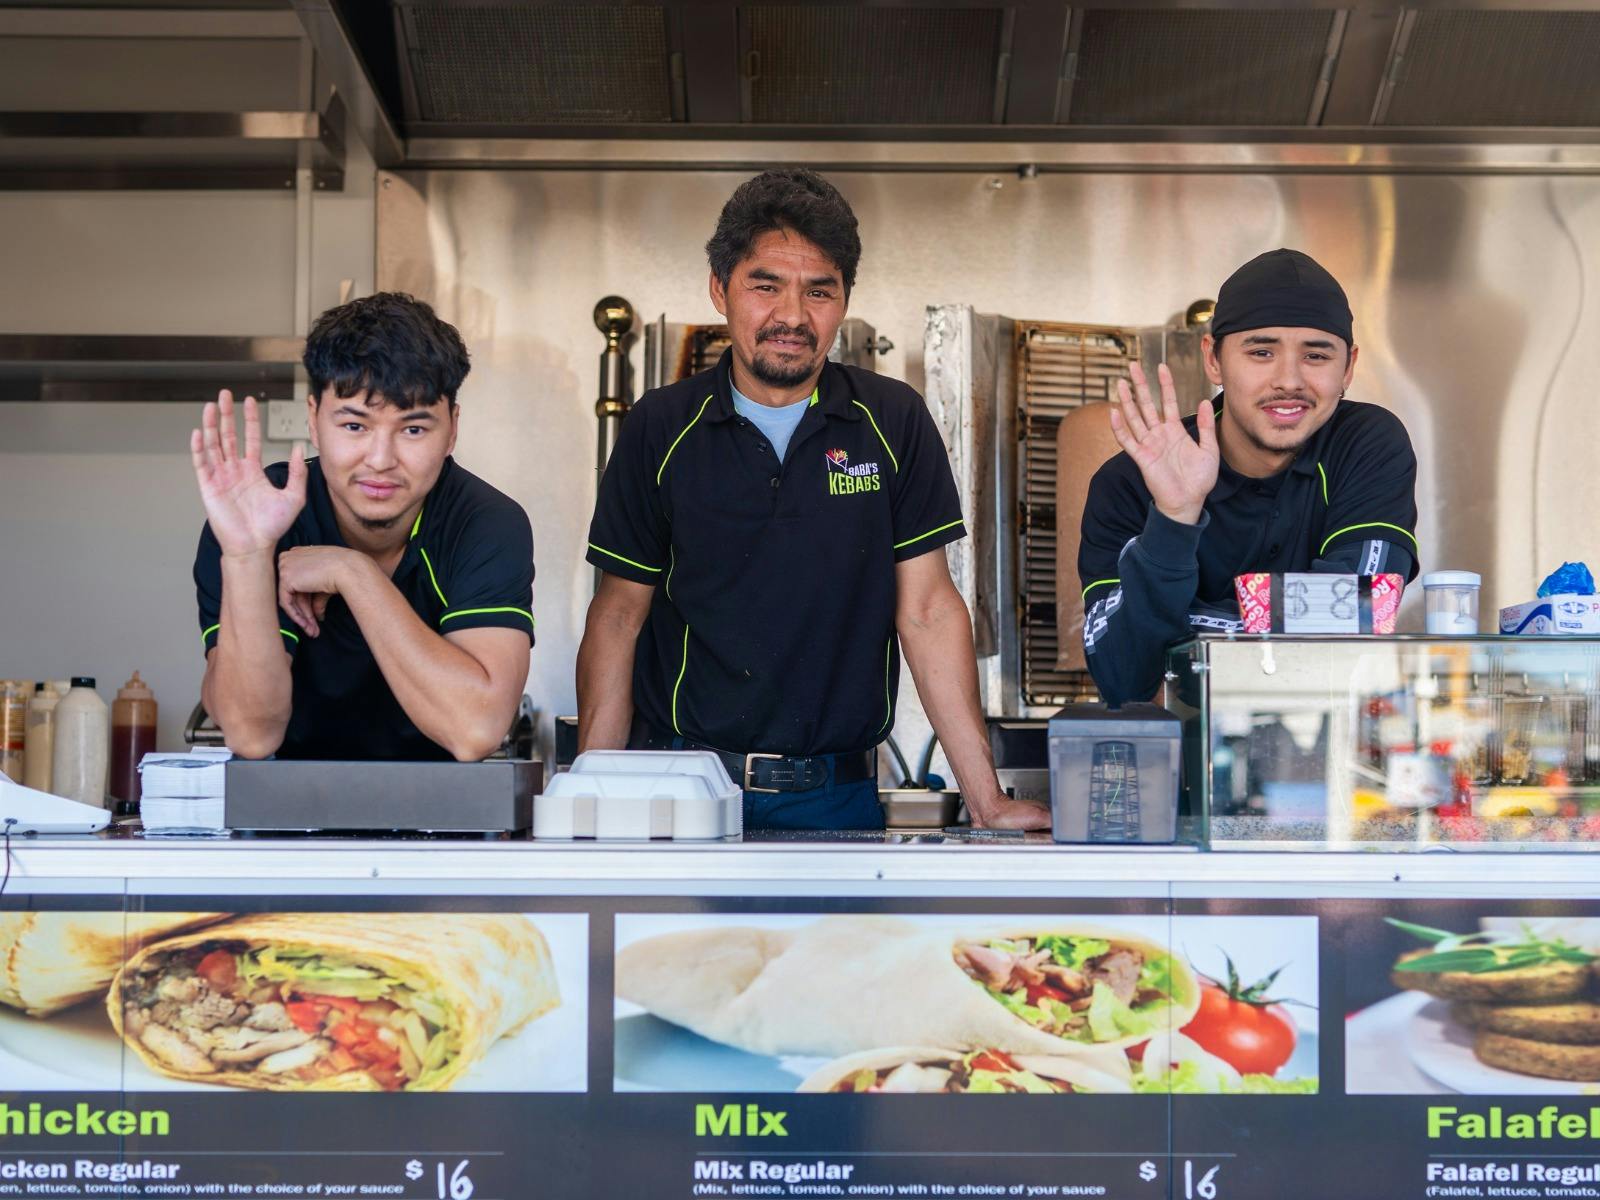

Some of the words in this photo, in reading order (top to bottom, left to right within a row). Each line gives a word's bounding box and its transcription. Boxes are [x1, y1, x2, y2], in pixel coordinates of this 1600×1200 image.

[848, 463, 878, 476] BABA'S
[829, 472, 880, 495] KEBABS
[1286, 579, 1309, 620] $
[1330, 578, 1358, 620] 8
[0, 1103, 169, 1135] hicken
[695, 1103, 788, 1136] Mix
[1427, 1106, 1600, 1139] Falafel
[0, 1160, 67, 1178] cken
[75, 1160, 180, 1182] Regular
[405, 1159, 424, 1180] $
[437, 1159, 474, 1200] 16
[694, 1161, 744, 1179] Mix
[749, 1161, 854, 1183] Regular
[1139, 1160, 1157, 1182] $
[1184, 1160, 1220, 1200] 16
[1426, 1163, 1519, 1181] Falafel
[27, 1183, 81, 1194] lettuce,
[85, 1183, 141, 1194] tomato,
[145, 1183, 191, 1194] onion)
[194, 1183, 224, 1193] with
[228, 1183, 252, 1193] the
[256, 1183, 303, 1193] choice
[307, 1183, 323, 1193] of
[325, 1185, 357, 1195] your
[360, 1185, 404, 1194] sauce
[693, 1184, 727, 1195] (Mix,
[732, 1184, 785, 1195] lettuce,
[789, 1184, 844, 1195] tomato,
[849, 1184, 894, 1195] onion)
[897, 1184, 927, 1195] with
[931, 1184, 955, 1195] the
[958, 1184, 1006, 1195] choice
[1009, 1184, 1024, 1195] of
[1027, 1186, 1059, 1197] your
[1062, 1186, 1106, 1195] sauce
[1425, 1186, 1484, 1197] (Falafel,
[1487, 1186, 1541, 1197] lettuce,
